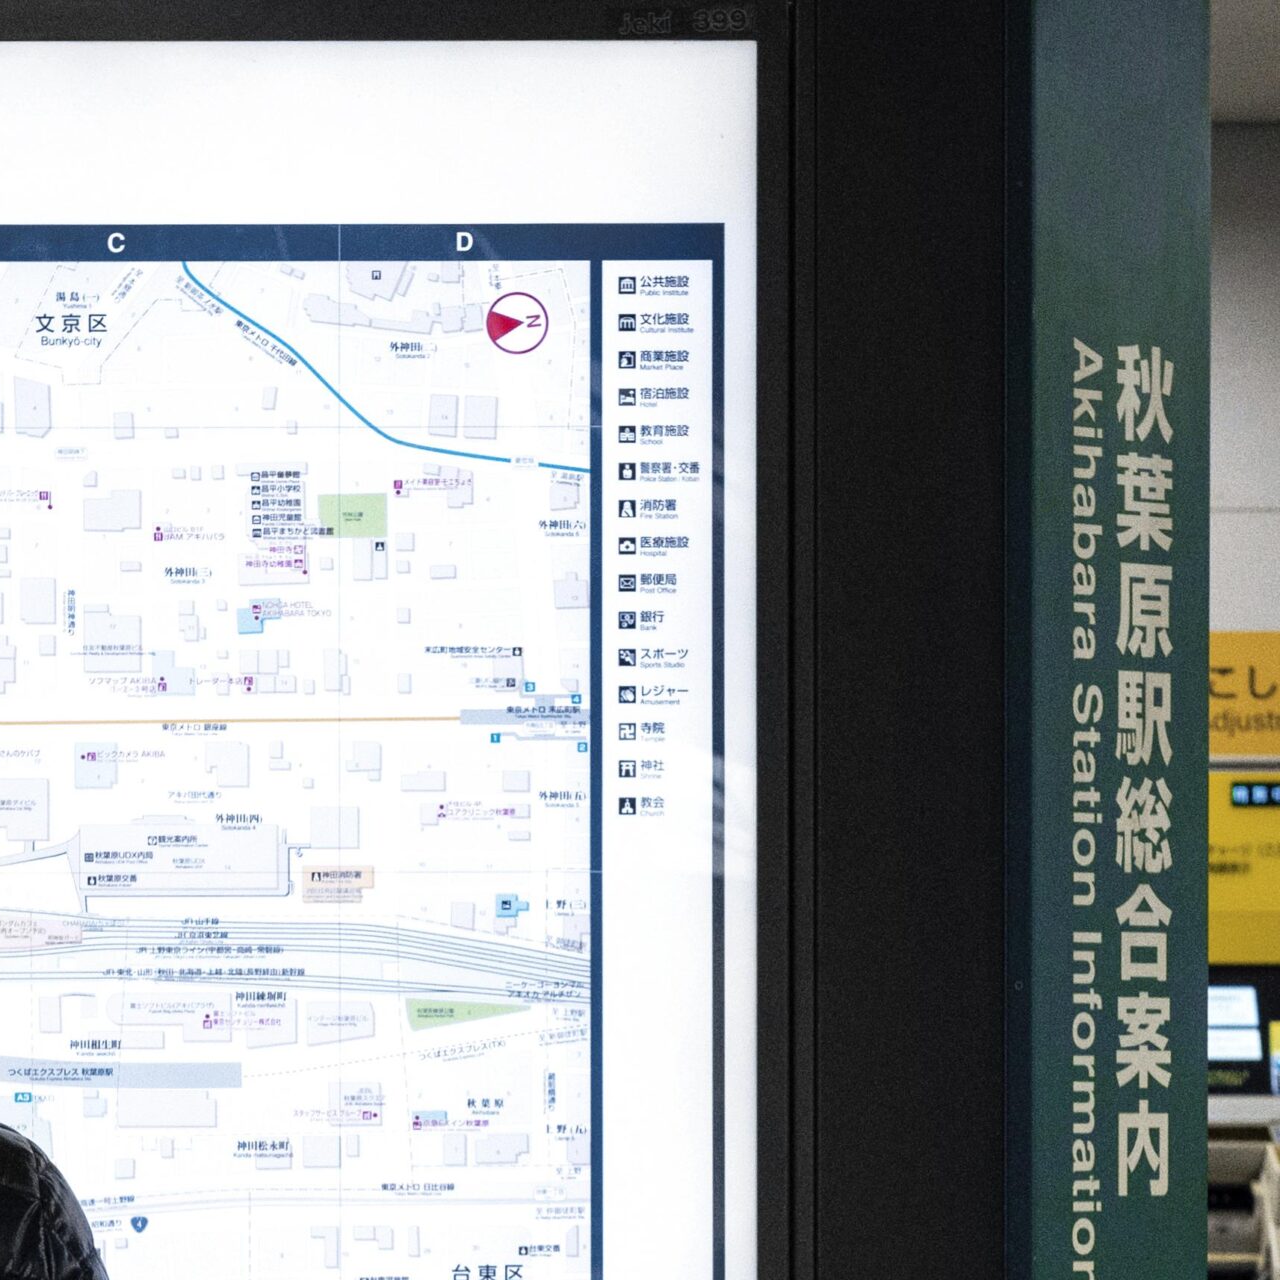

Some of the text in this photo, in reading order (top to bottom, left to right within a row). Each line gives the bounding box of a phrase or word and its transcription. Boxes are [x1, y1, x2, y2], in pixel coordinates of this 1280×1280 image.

[107, 233, 125, 252] C
[457, 232, 472, 251] D
[640, 276, 689, 288] 公共施設
[35, 314, 108, 333] 文京区
[640, 313, 689, 325] 文化施設
[640, 350, 689, 362] 商業施設
[640, 388, 689, 400] 宿泊施設
[640, 425, 689, 437] 教育施設
[1072, 337, 1104, 660] Akihabara
[640, 500, 677, 511] 消防署
[640, 536, 689, 549] 医療施設
[640, 574, 677, 586] 郵便局
[640, 611, 665, 623] 銀行
[640, 648, 689, 660] スポーツ
[641, 685, 689, 697] レジャー
[162, 723, 201, 731] 東京メトロ
[640, 722, 665, 734] 寺院
[640, 760, 664, 772] 神社
[1116, 344, 1174, 1198] 秋葉原駅総合案内
[1072, 684, 1104, 906] Station
[640, 797, 664, 809] 教会
[8, 1068, 79, 1076] つくばエクスプレス
[467, 1098, 504, 1109] 秋葉原
[381, 1183, 420, 1191] 東京メトロ
